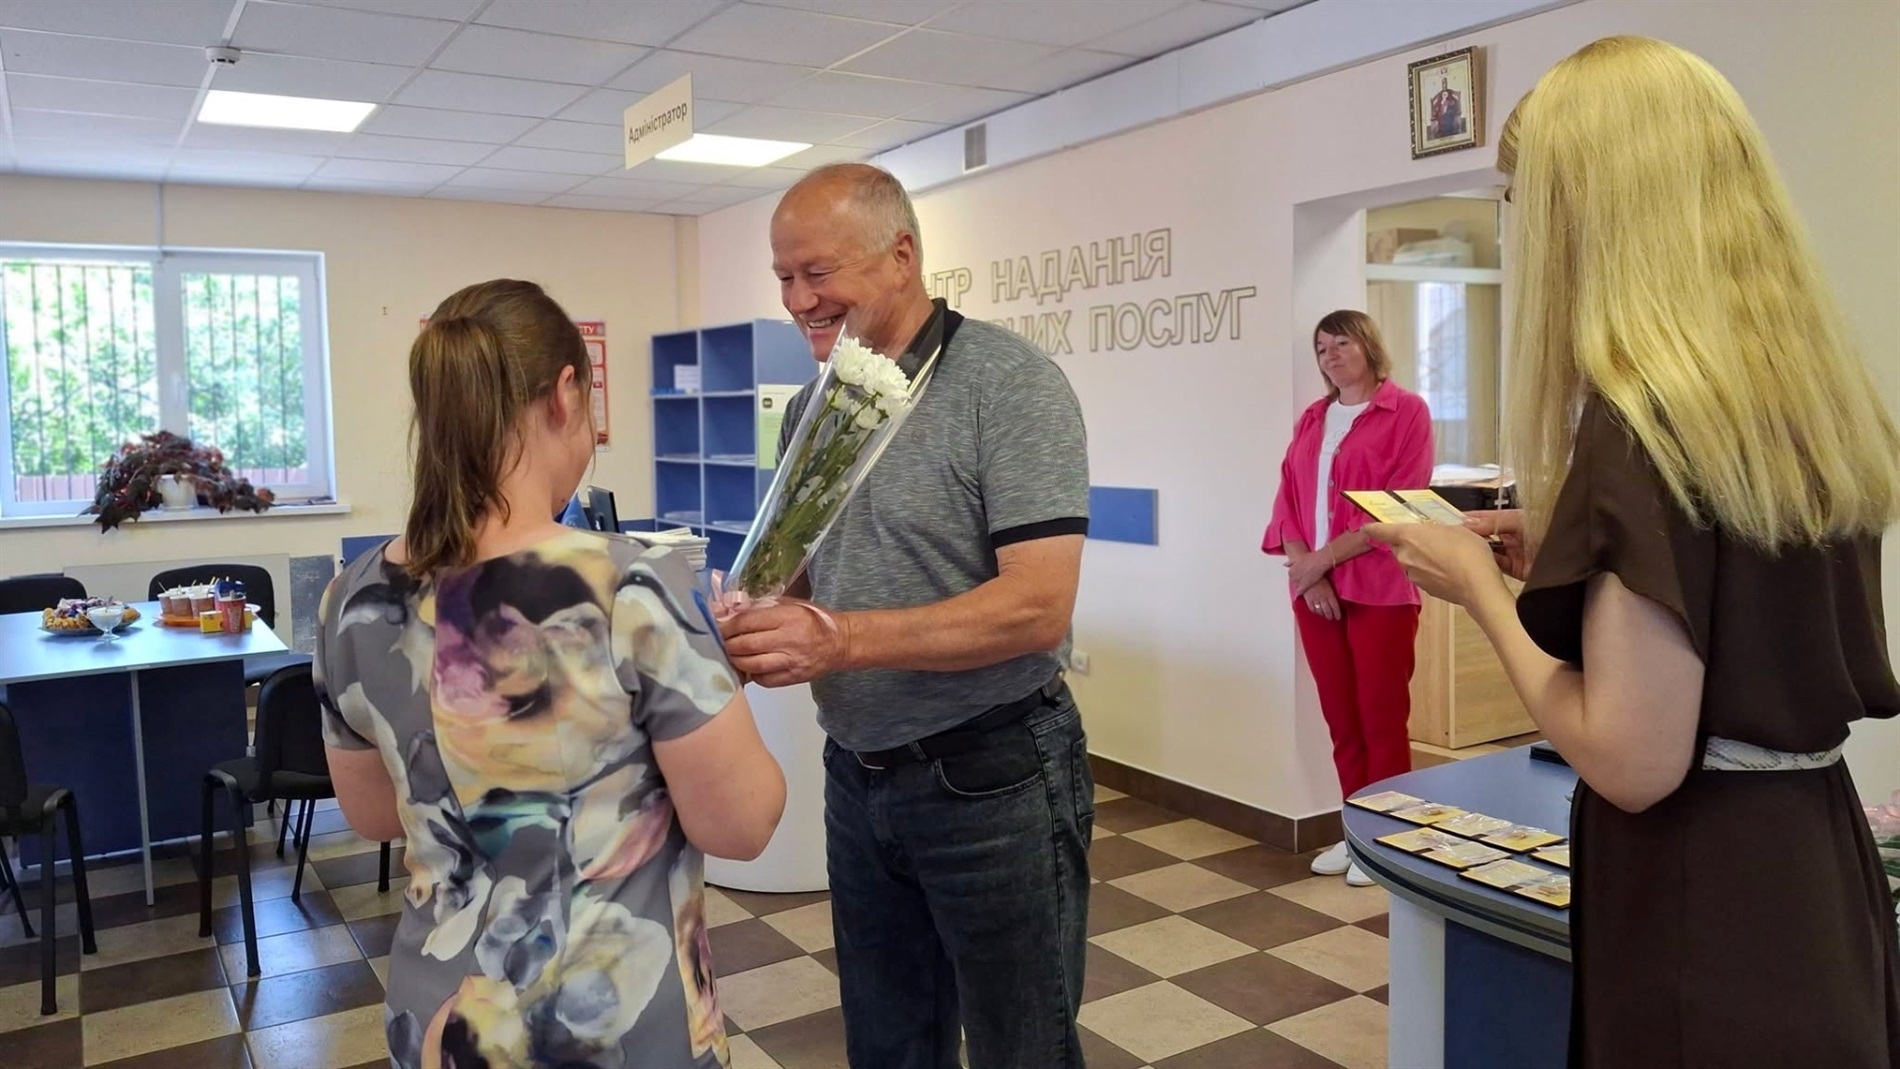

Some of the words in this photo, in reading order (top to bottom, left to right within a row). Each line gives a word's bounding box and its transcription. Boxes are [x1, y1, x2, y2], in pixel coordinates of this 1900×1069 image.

[628, 102, 688, 145] Адміністратор
[991, 227, 1172, 306] НАДАННЯ
[1089, 286, 1257, 353] ПОСЛУГ
